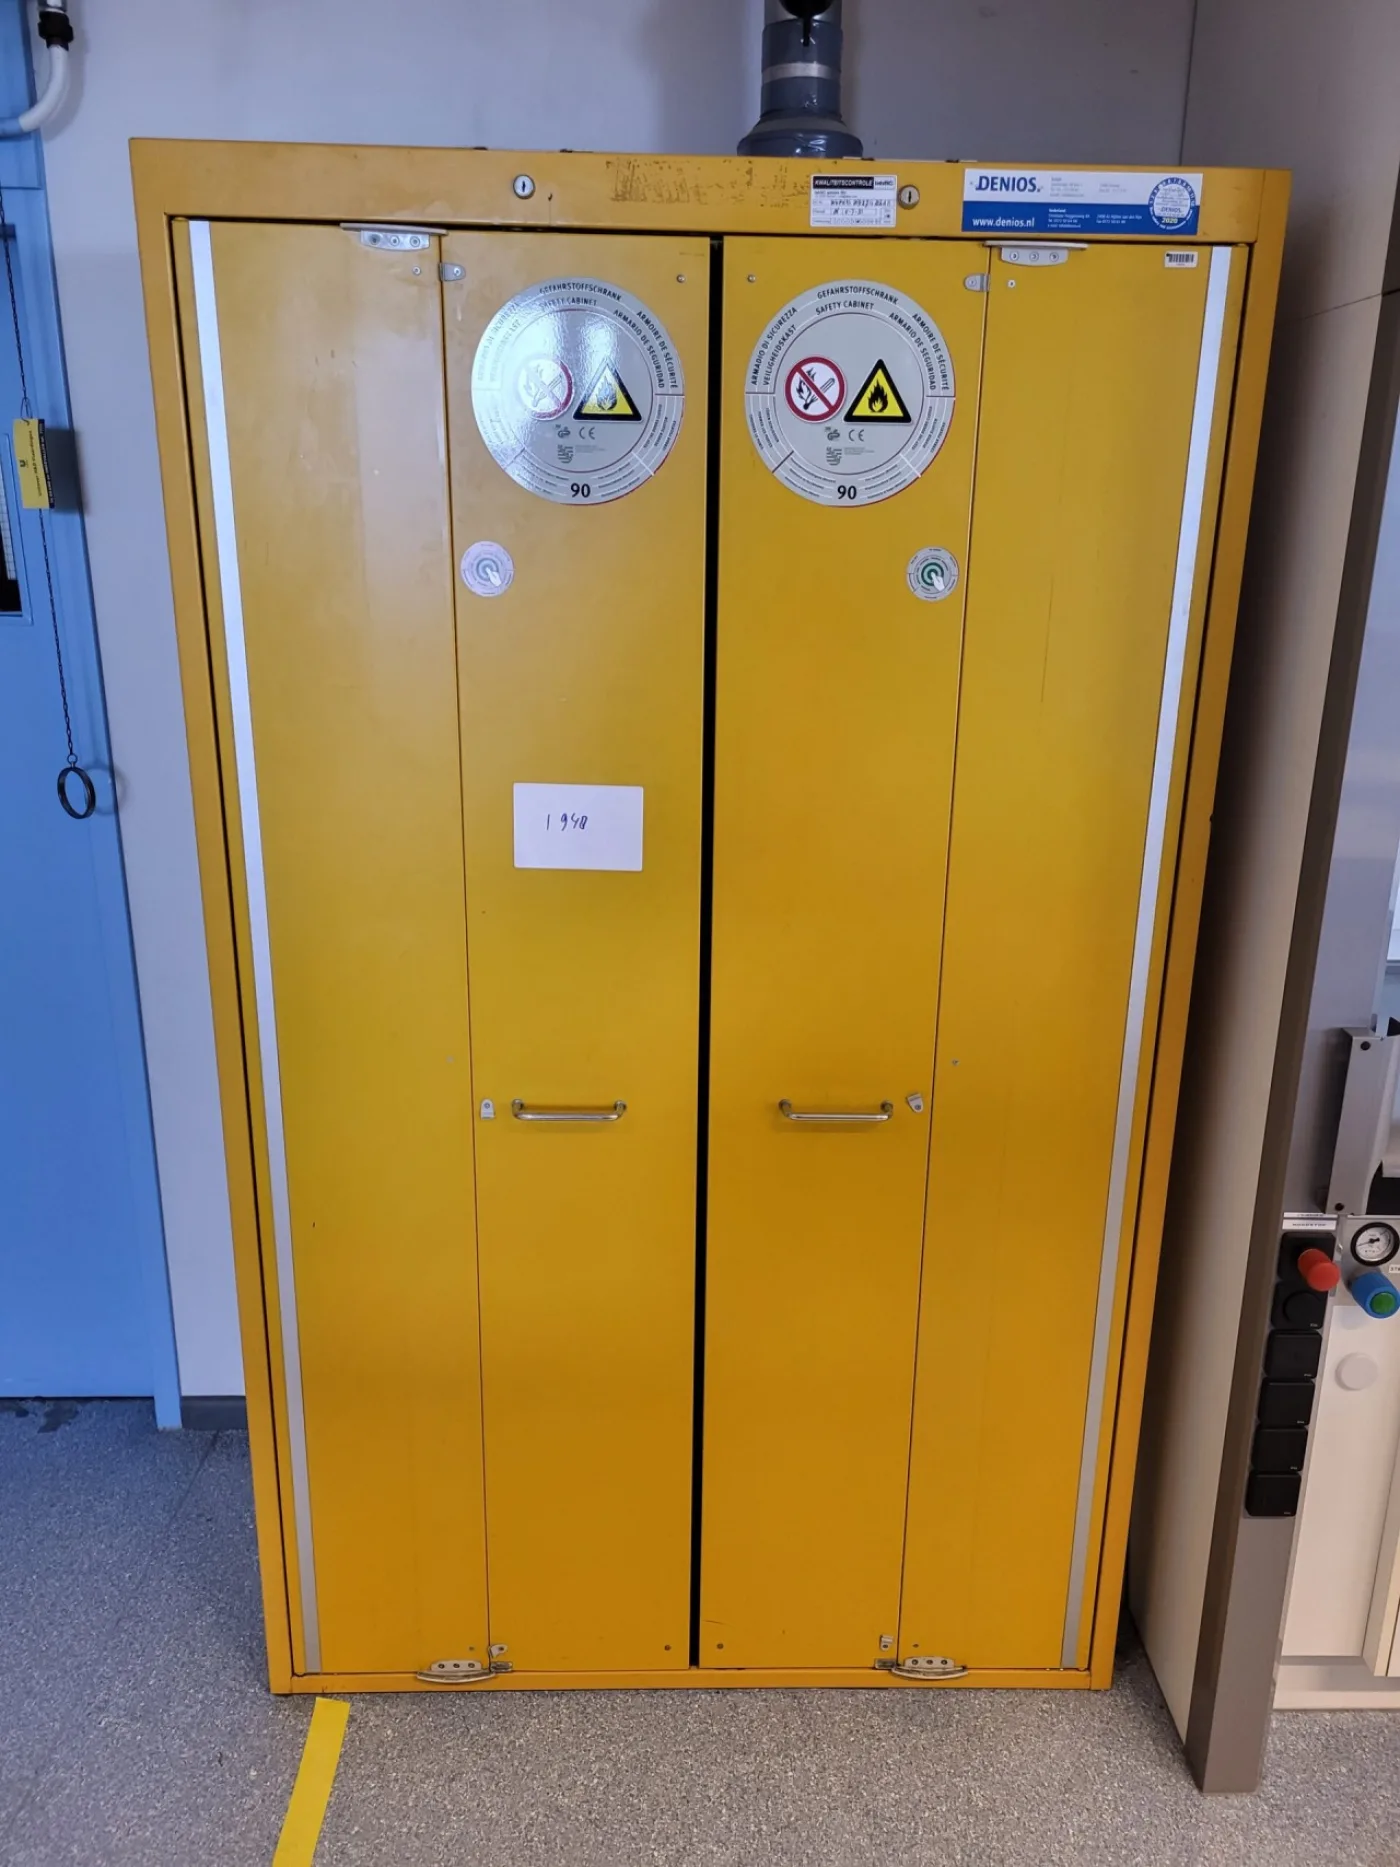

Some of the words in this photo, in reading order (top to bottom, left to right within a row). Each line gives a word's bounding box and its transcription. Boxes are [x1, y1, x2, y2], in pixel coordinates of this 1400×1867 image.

[972, 216, 1035, 228] www.denios.nl
[815, 301, 842, 316] SAFETY
[843, 300, 875, 311] CABINET
[817, 285, 899, 305] GEFAHRSTOFFSCHRANK
[613, 309, 642, 337] ARMARIO
[640, 334, 649, 346] DE
[647, 345, 665, 389] SEGURIDAD
[636, 310, 662, 342] ARMOIRE
[659, 341, 668, 352] DE
[750, 350, 766, 386] ARMADIO
[761, 340, 771, 351] DI
[767, 306, 798, 341] SICUREZZA
[888, 312, 917, 339] ARMARIO
[914, 336, 923, 348] DE
[920, 347, 937, 391] SEGURIDAD
[912, 313, 937, 343] ARMOIRE
[932, 343, 942, 354] DE
[762, 324, 797, 387] VEILIGHEIDSKAST
[570, 483, 591, 498] 90
[837, 485, 858, 500] 90
